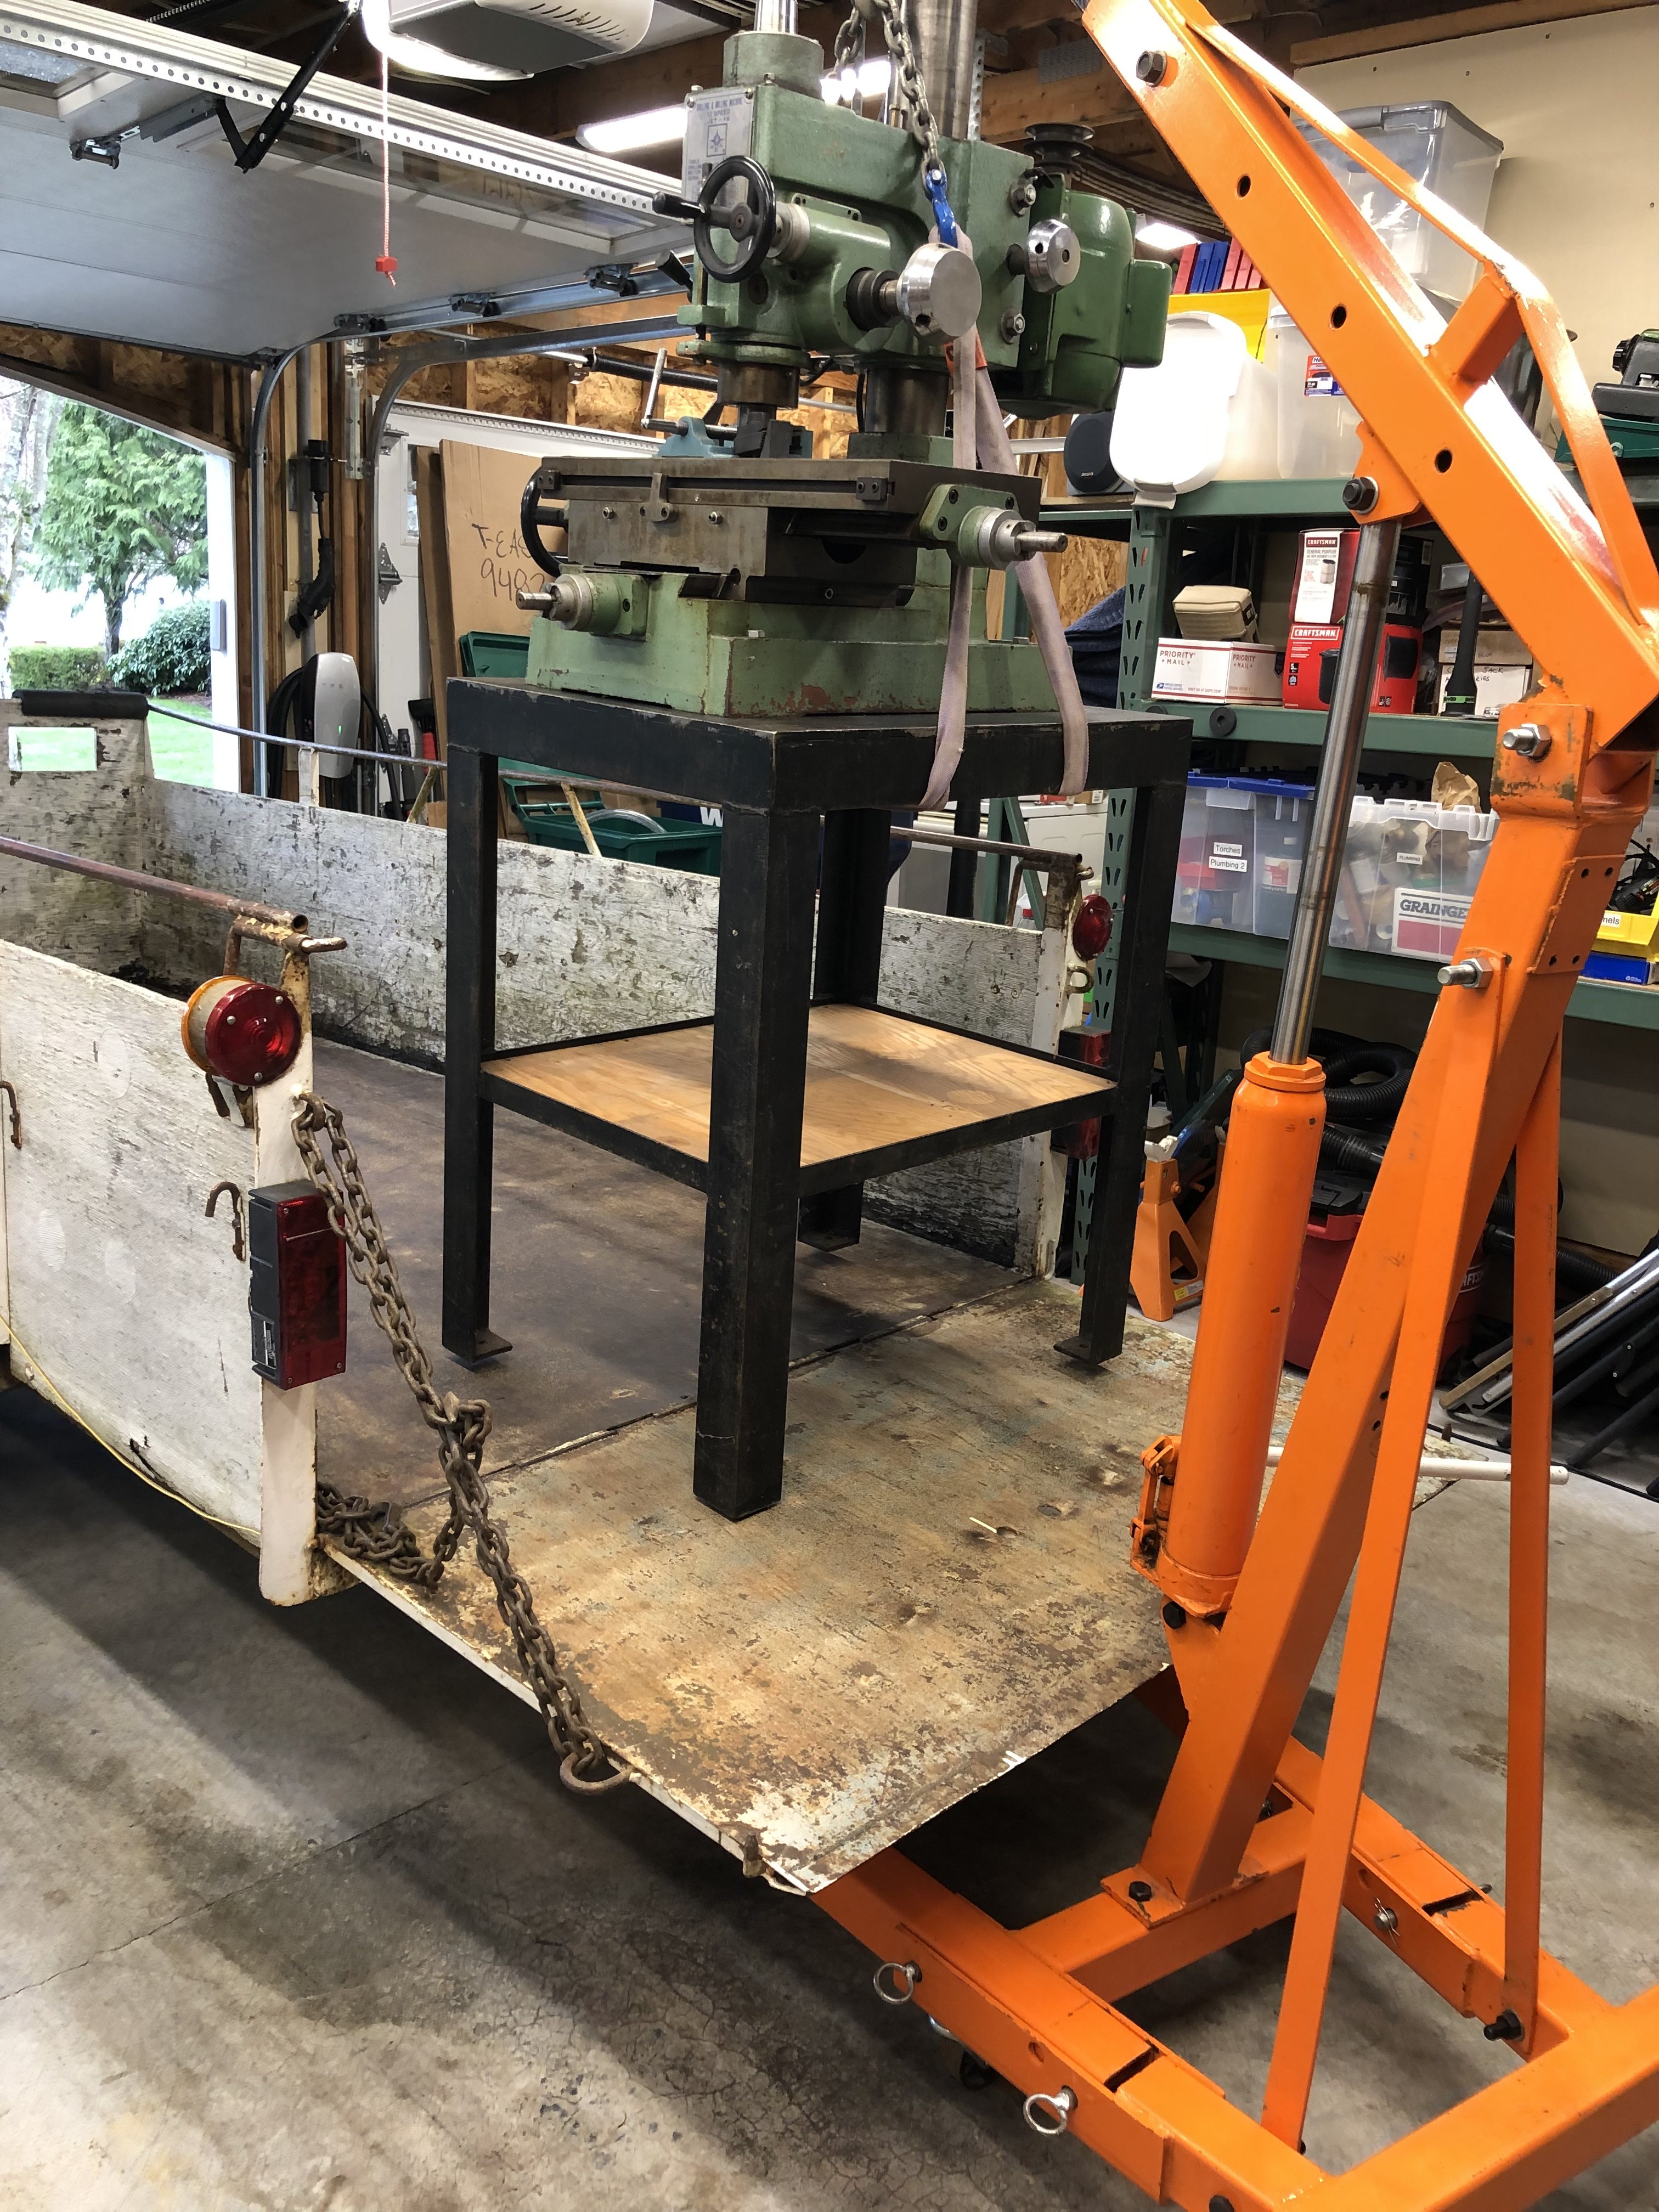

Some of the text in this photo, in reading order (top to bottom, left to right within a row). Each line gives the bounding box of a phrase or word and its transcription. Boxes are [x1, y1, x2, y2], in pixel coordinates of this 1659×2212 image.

[1160, 651, 1194, 659] PRIORITY
[1233, 654, 1255, 662] PRIORITY
[1215, 845, 1240, 854] Torches
[1210, 859, 1239, 869] Plumbing
[1400, 899, 1471, 919] GRAINGE
[1602, 917, 1620, 925] nels
